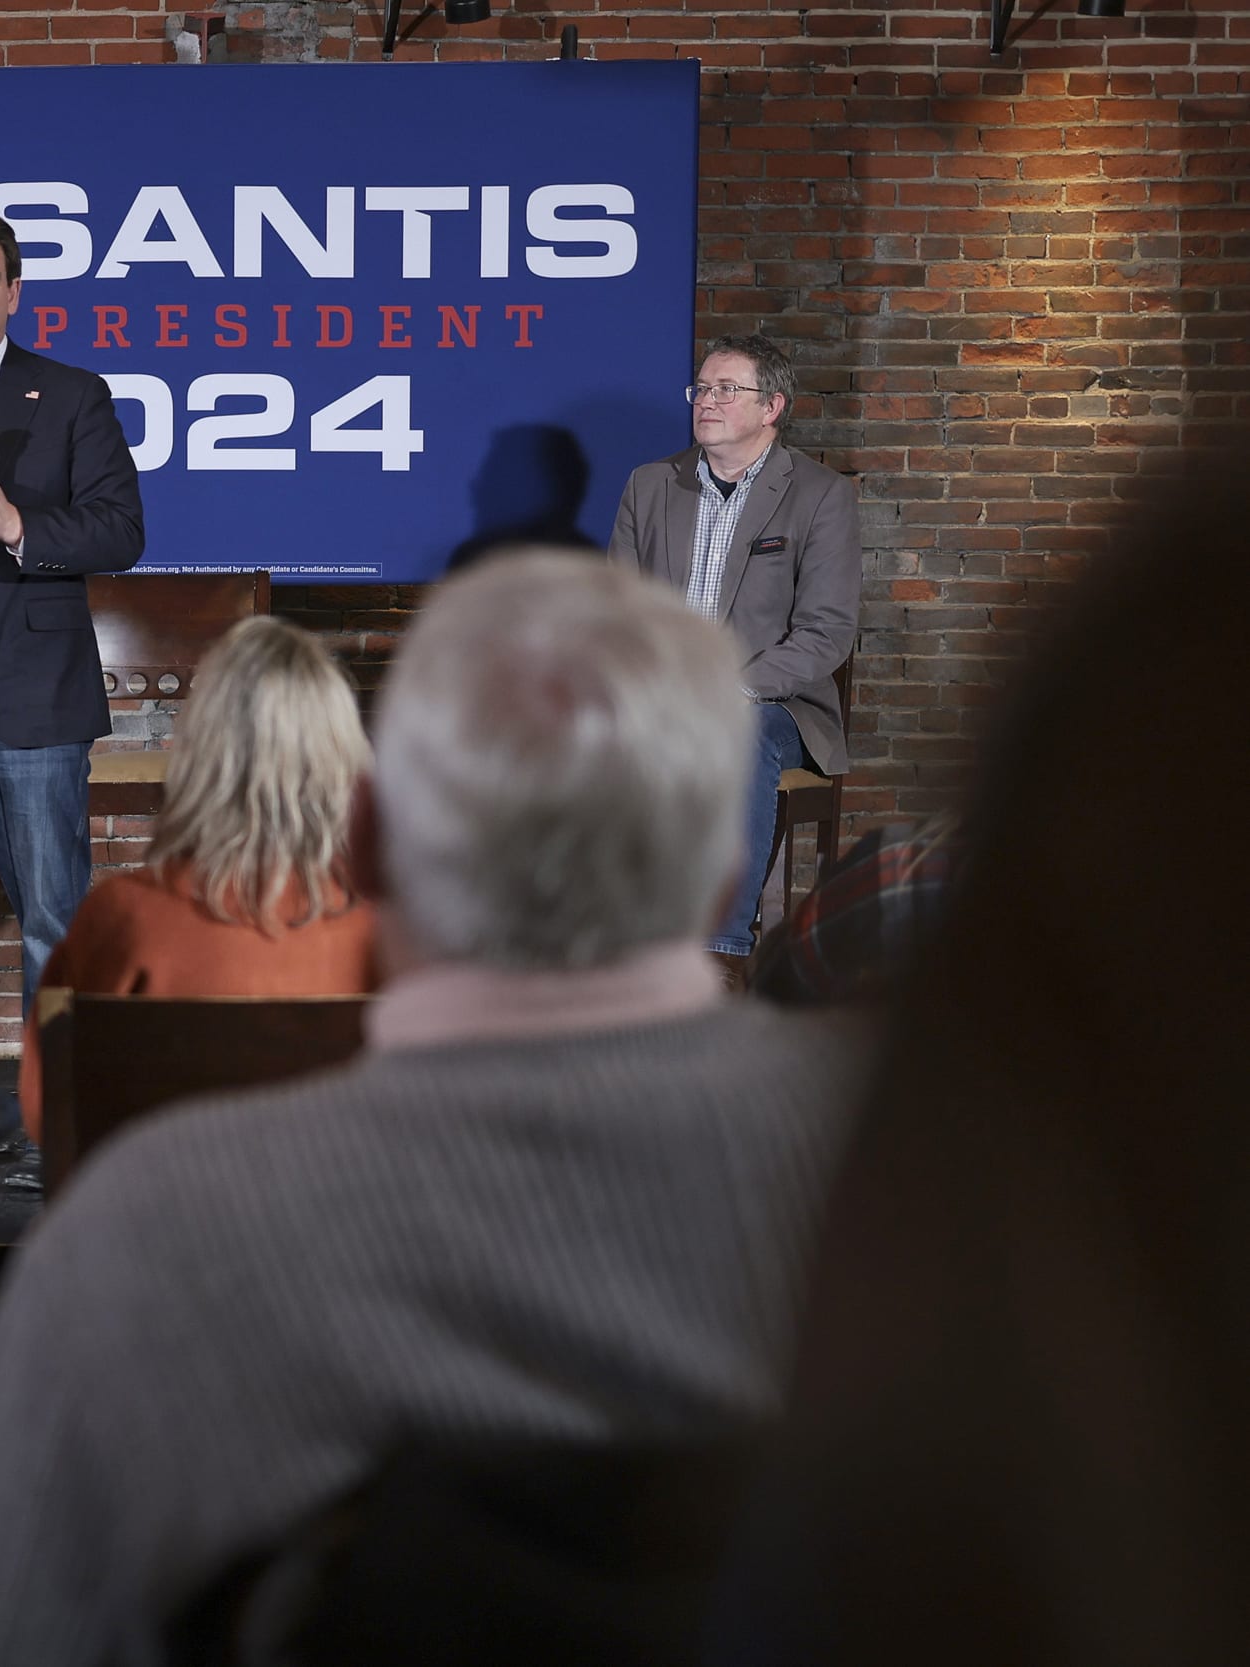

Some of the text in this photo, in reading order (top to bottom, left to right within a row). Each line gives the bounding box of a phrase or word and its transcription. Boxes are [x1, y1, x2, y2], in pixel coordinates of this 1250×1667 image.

[33, 304, 544, 349] PRESIDENT
[98, 372, 425, 472] 024
[233, 565, 242, 574] by
[242, 566, 255, 574] any
